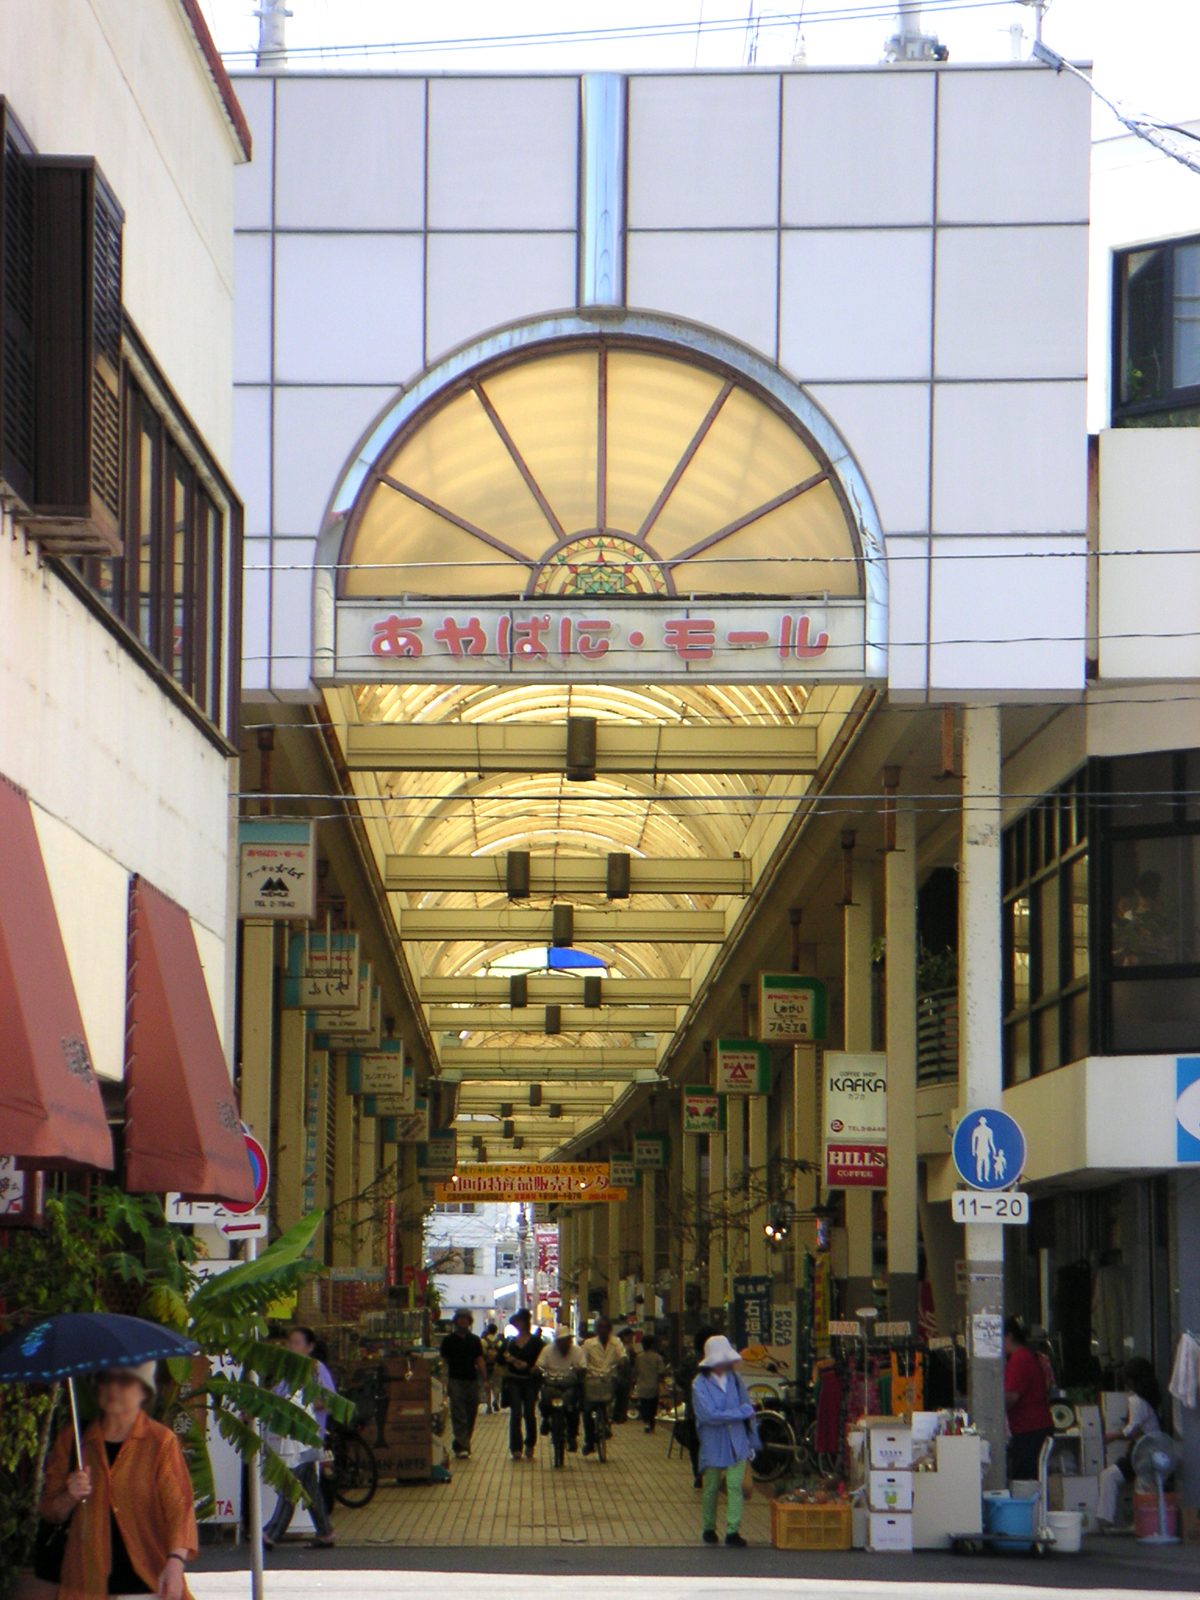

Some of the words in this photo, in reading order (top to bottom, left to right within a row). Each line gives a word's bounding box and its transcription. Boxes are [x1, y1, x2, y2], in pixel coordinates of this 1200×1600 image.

[370, 614, 830, 660] あやぱに・モール
[829, 1078, 886, 1092] KAFKA
[837, 1169, 873, 1178] COFFEE
[173, 1199, 250, 1217] 11-2
[958, 1198, 1022, 1217] 11-20
